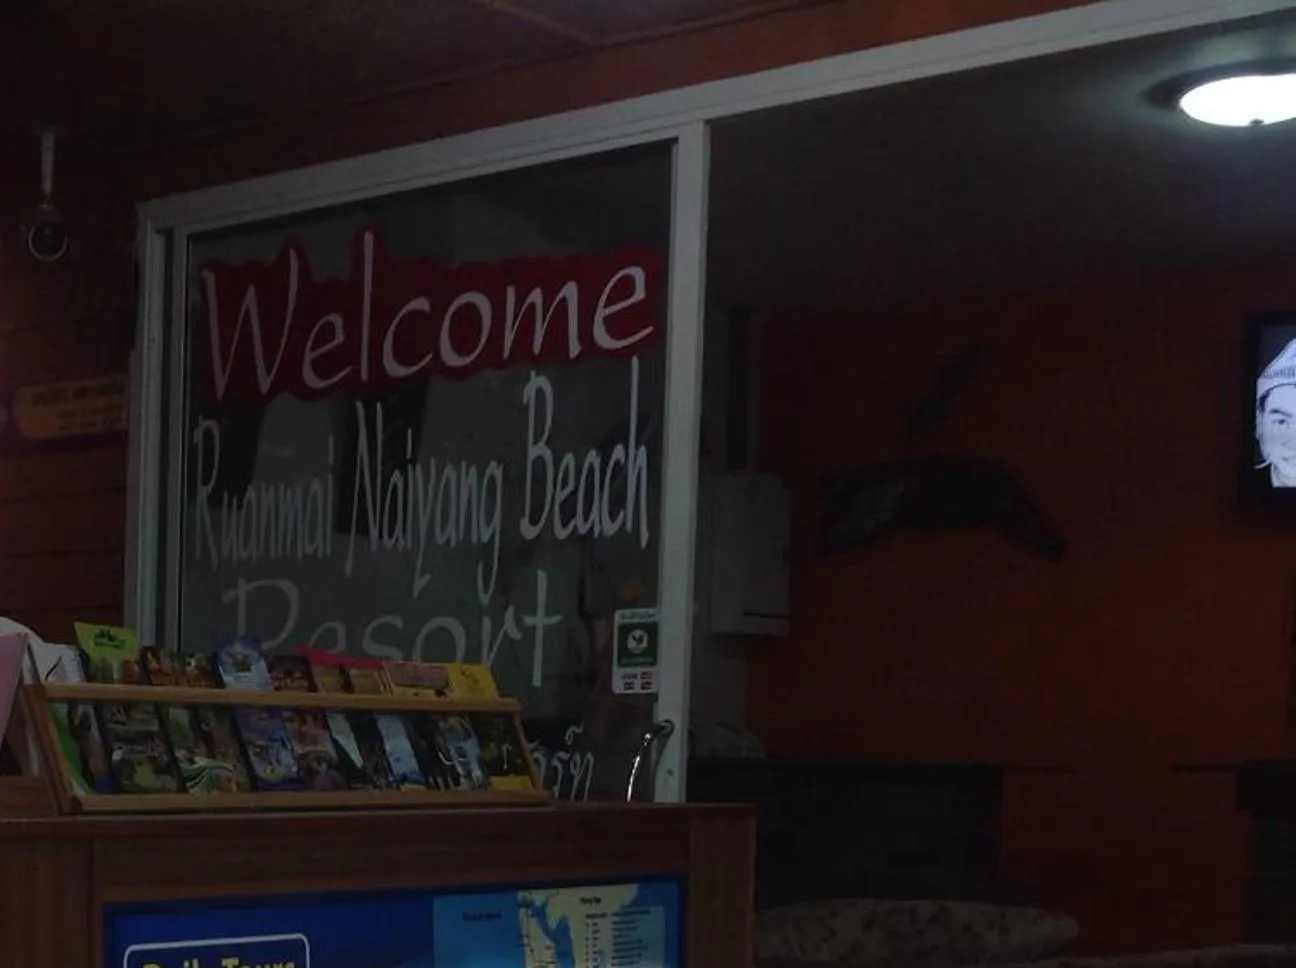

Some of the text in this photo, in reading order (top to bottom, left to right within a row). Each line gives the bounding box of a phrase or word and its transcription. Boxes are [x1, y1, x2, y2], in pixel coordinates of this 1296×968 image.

[202, 231, 654, 400] Welcome
[344, 400, 503, 604] Naiyang
[518, 355, 649, 549] Beach
